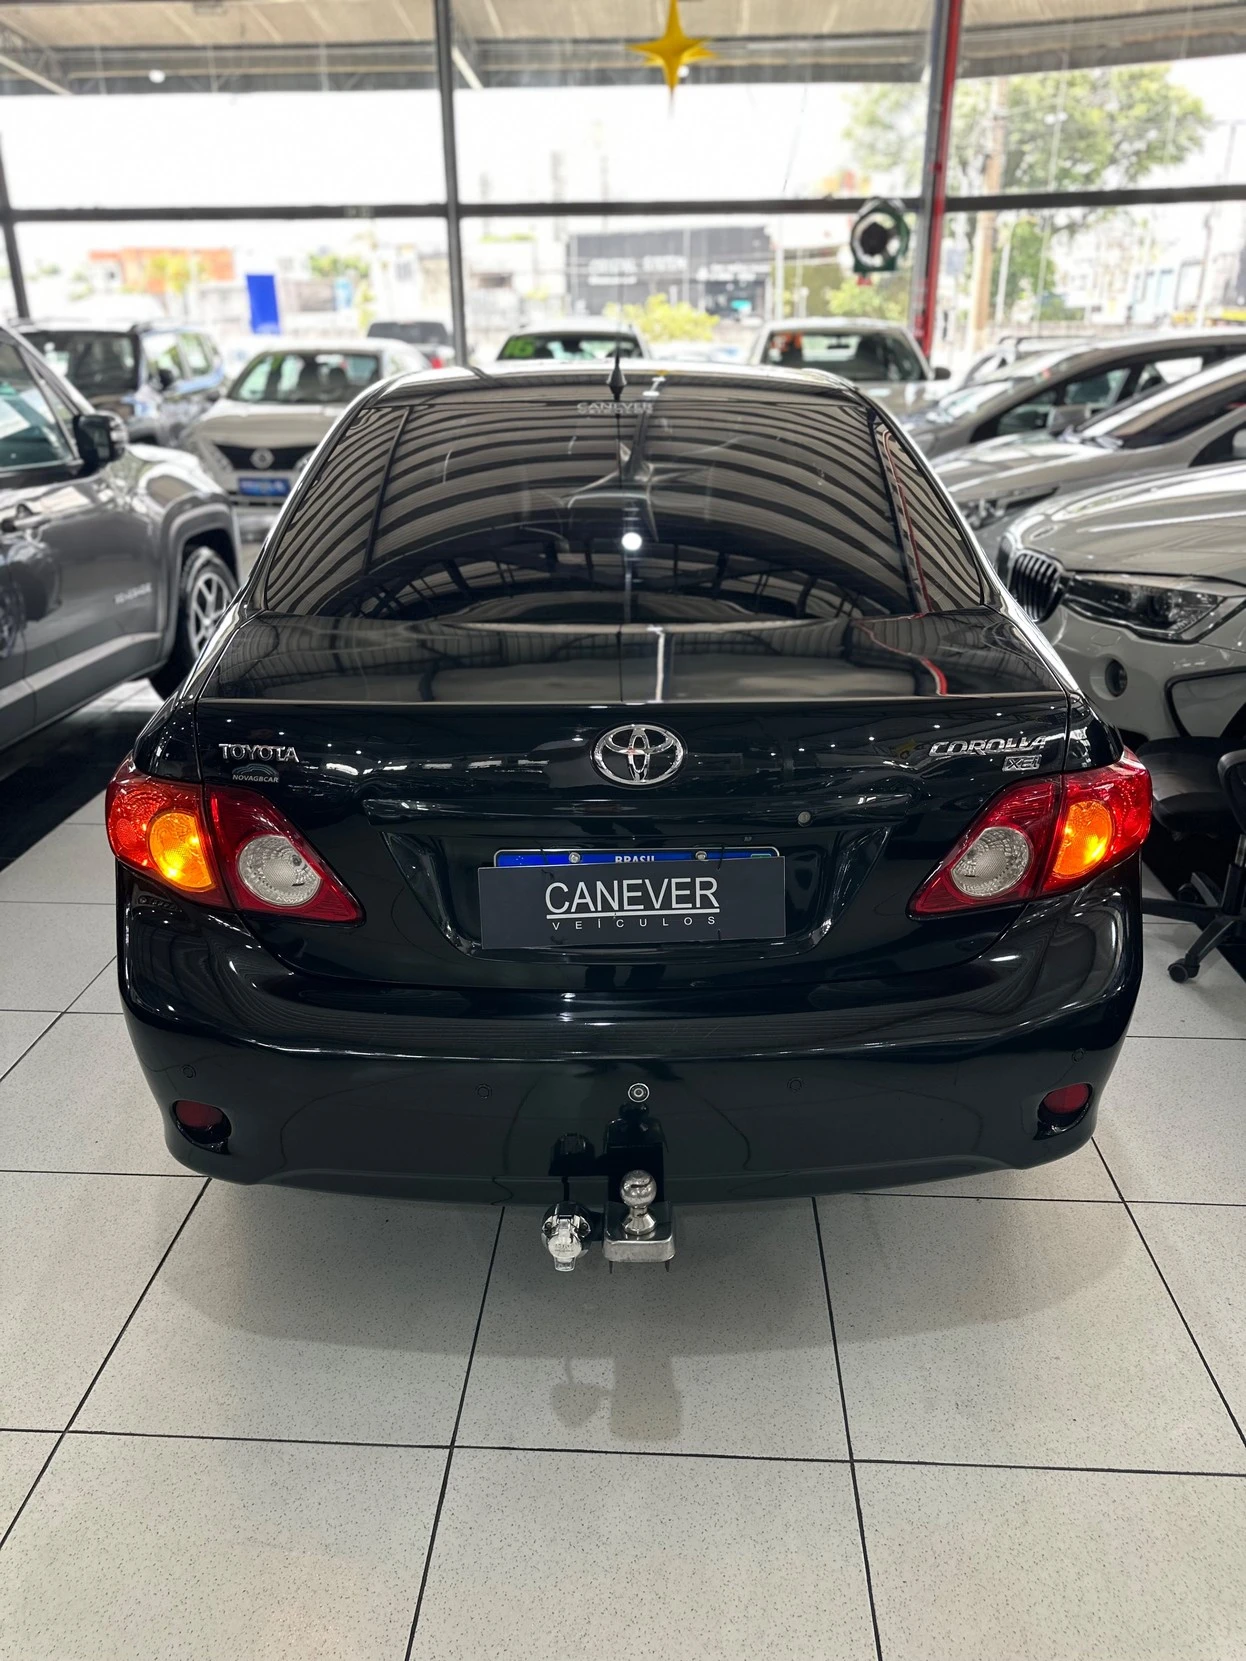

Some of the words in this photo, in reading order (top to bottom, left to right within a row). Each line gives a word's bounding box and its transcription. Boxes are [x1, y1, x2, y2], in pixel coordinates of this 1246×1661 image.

[218, 743, 300, 763] TOYOTA
[928, 735, 1047, 757] COROLLA
[545, 877, 720, 914] CANEVER
